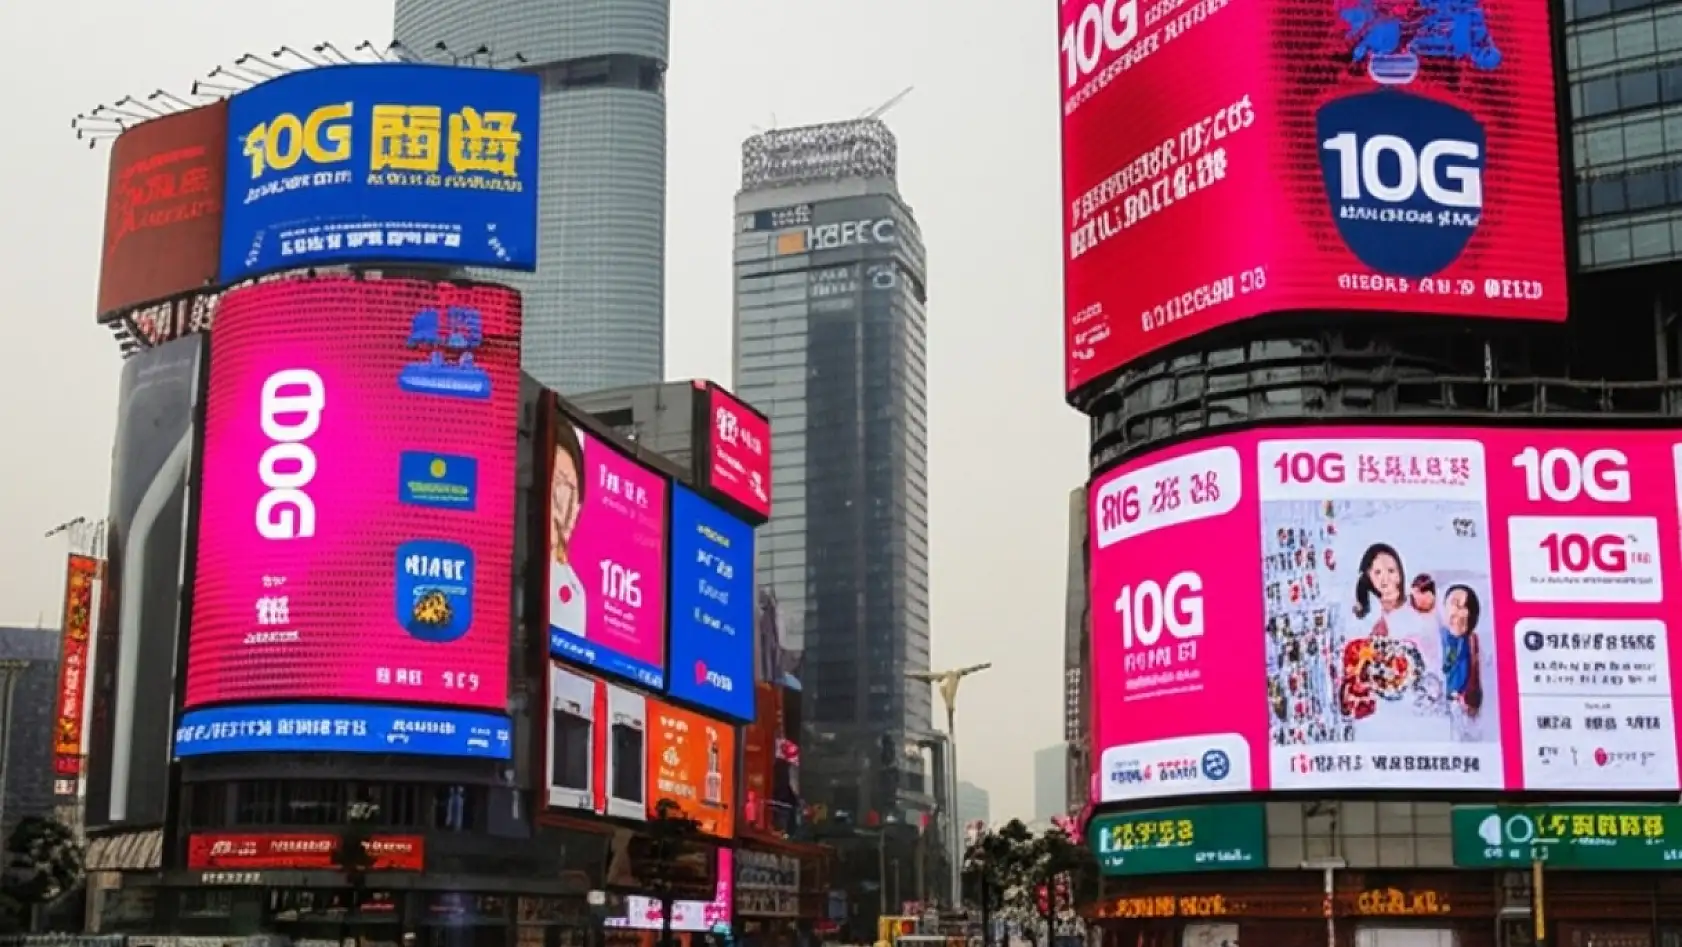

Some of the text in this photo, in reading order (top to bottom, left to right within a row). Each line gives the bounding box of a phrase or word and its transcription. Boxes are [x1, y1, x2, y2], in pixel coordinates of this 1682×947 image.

[243, 101, 352, 179] 10G
[1323, 132, 1483, 208] 10G
[1274, 451, 1345, 484] 10G
[1512, 446, 1632, 503] 10G
[1539, 532, 1628, 573] 10G
[1114, 570, 1205, 650] 10G
